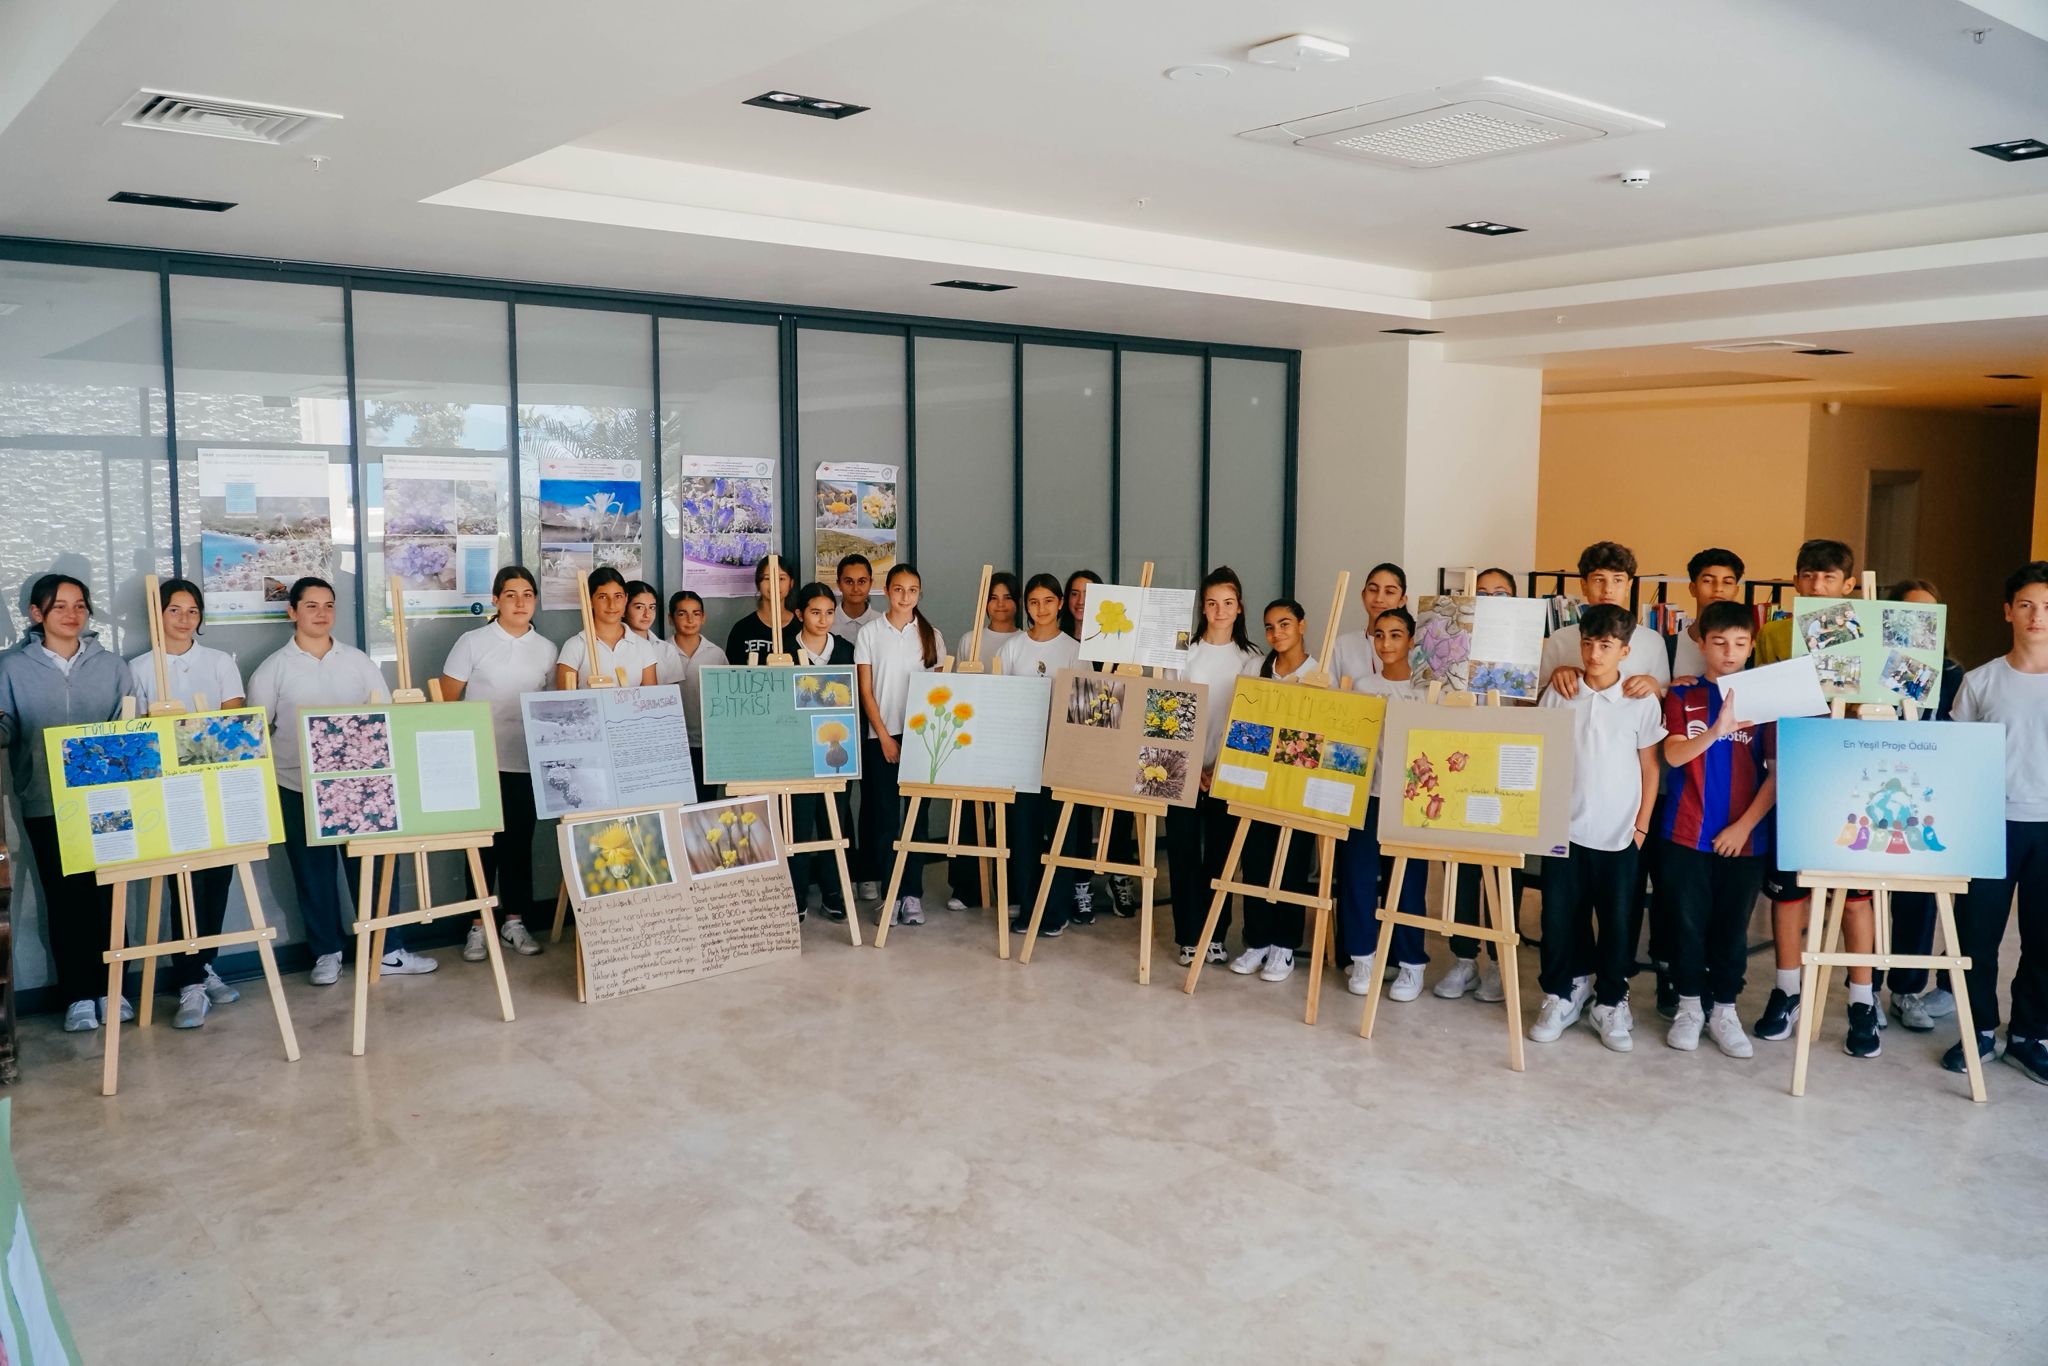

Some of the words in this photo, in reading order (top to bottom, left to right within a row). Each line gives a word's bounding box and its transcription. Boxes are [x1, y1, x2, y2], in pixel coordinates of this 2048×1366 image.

[1717, 730, 1753, 745] potify
[1843, 740, 1855, 749] En
[1858, 740, 1880, 751] Yeşil
[1882, 741, 1906, 752] Proje
[1908, 739, 1938, 751] Ödülü
